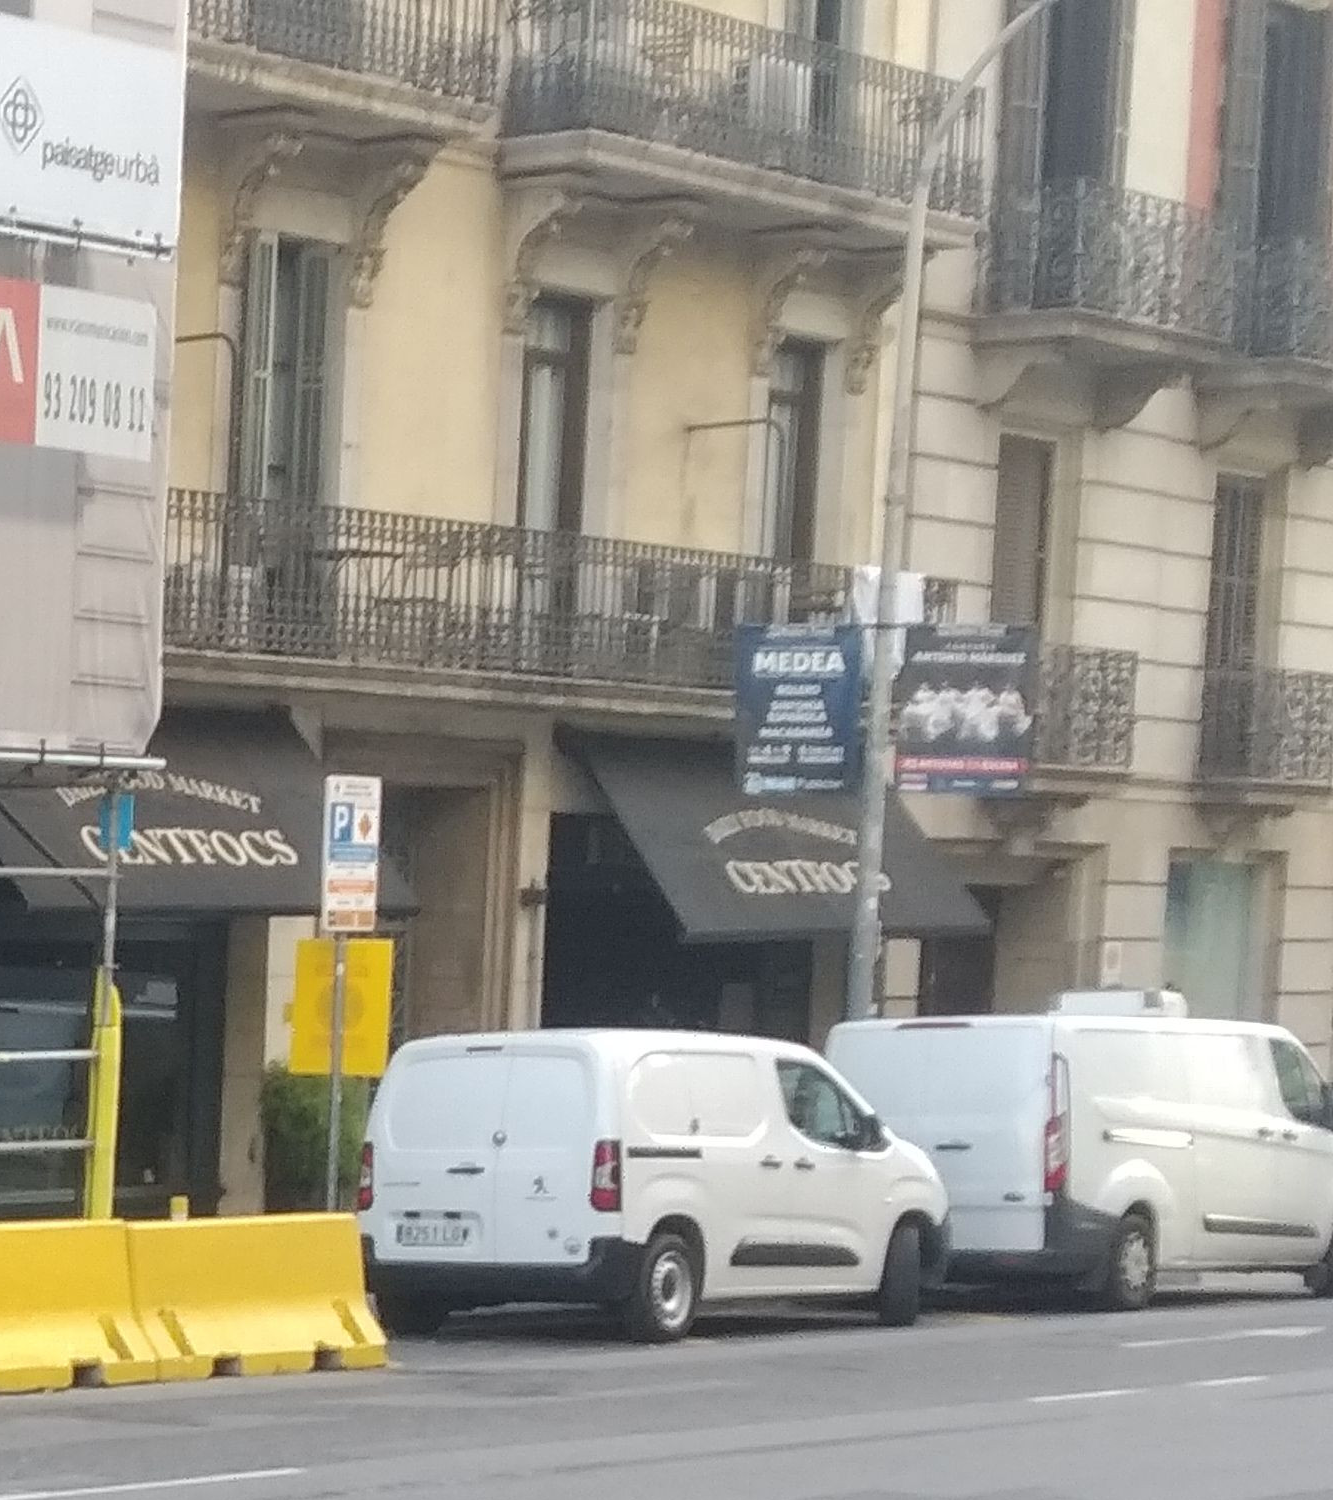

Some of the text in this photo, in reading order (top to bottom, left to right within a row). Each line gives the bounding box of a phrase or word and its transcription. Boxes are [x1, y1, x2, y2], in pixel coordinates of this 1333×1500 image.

[43, 371, 62, 420] 93
[68, 374, 97, 425] 209
[103, 381, 122, 431] 08
[752, 650, 846, 673] MEDEA
